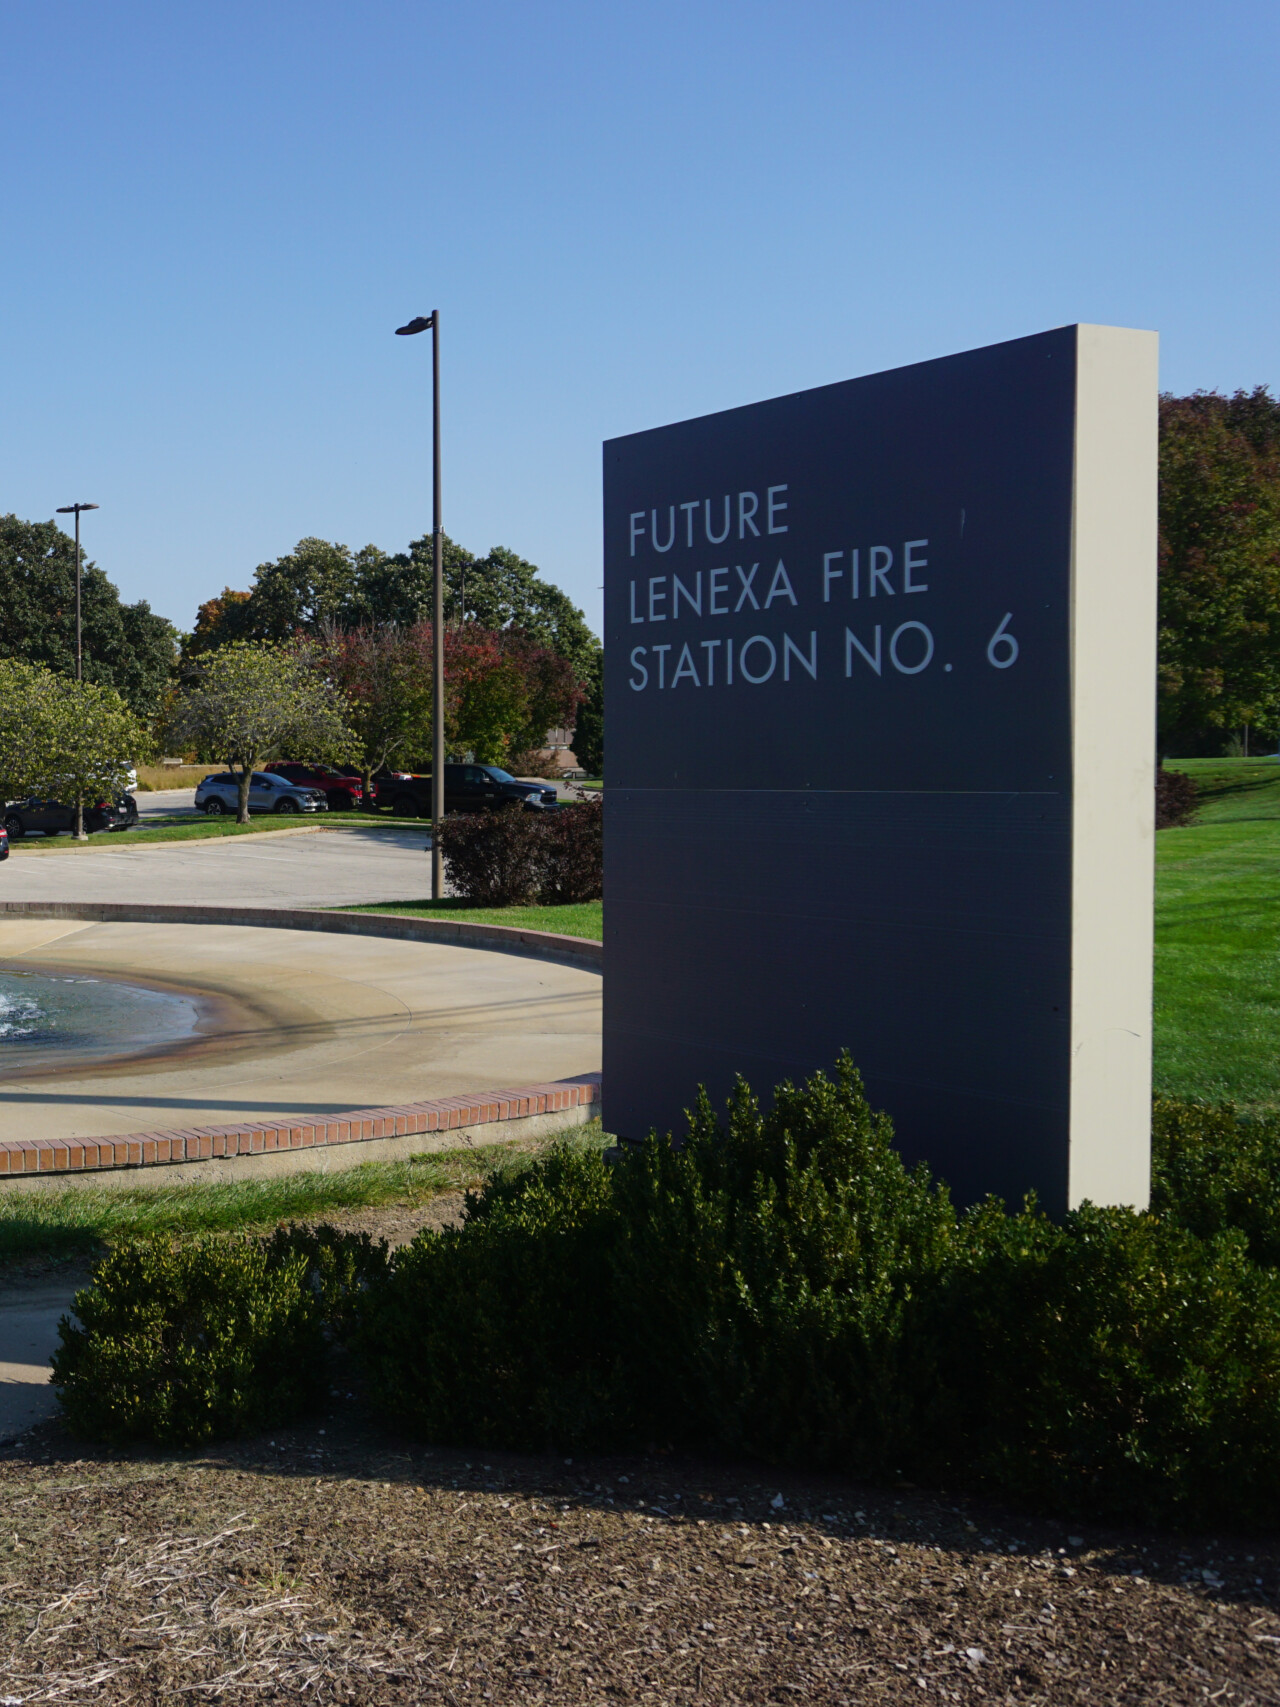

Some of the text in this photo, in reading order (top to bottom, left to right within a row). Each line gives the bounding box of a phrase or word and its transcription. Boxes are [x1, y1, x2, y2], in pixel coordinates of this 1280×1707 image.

[629, 483, 789, 557] FUTURE
[630, 538, 929, 625] LENEXA FIRE
[628, 611, 1019, 692] STATION NO. 6
